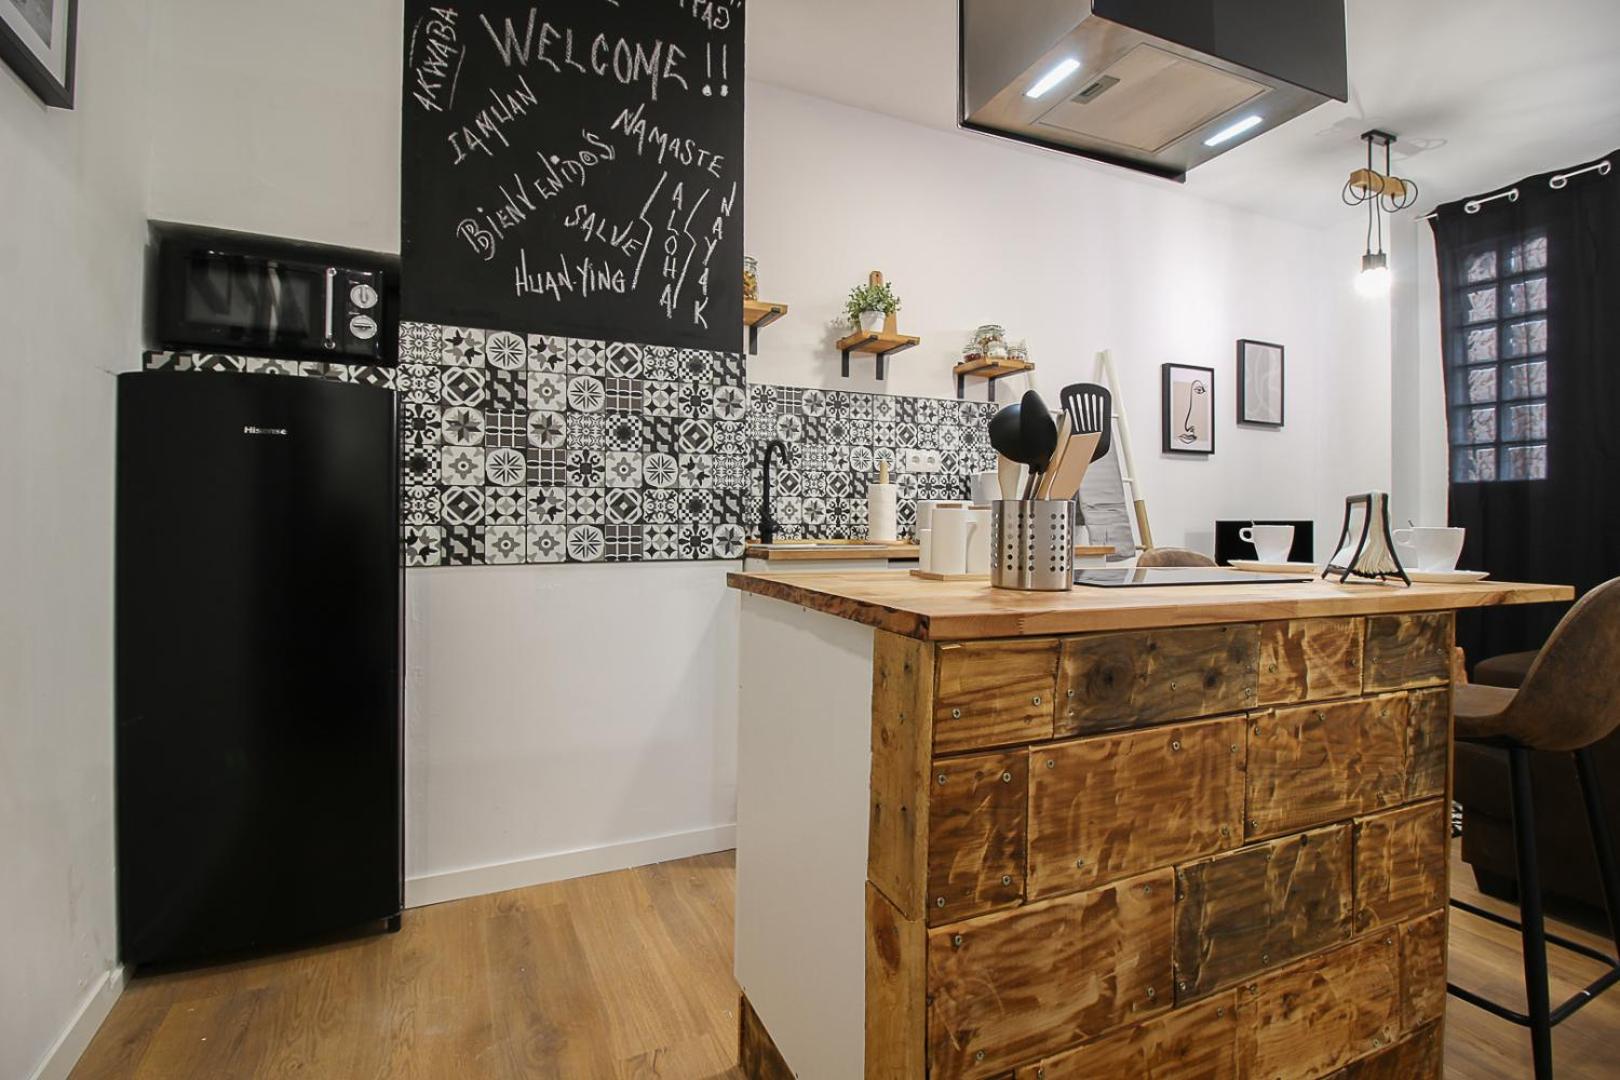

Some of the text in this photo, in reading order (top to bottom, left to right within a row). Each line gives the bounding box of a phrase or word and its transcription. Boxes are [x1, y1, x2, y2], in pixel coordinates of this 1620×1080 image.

[479, 7, 689, 101] WELCOME
[610, 103, 725, 178] NAMASTE
[563, 204, 643, 257] SALVE
